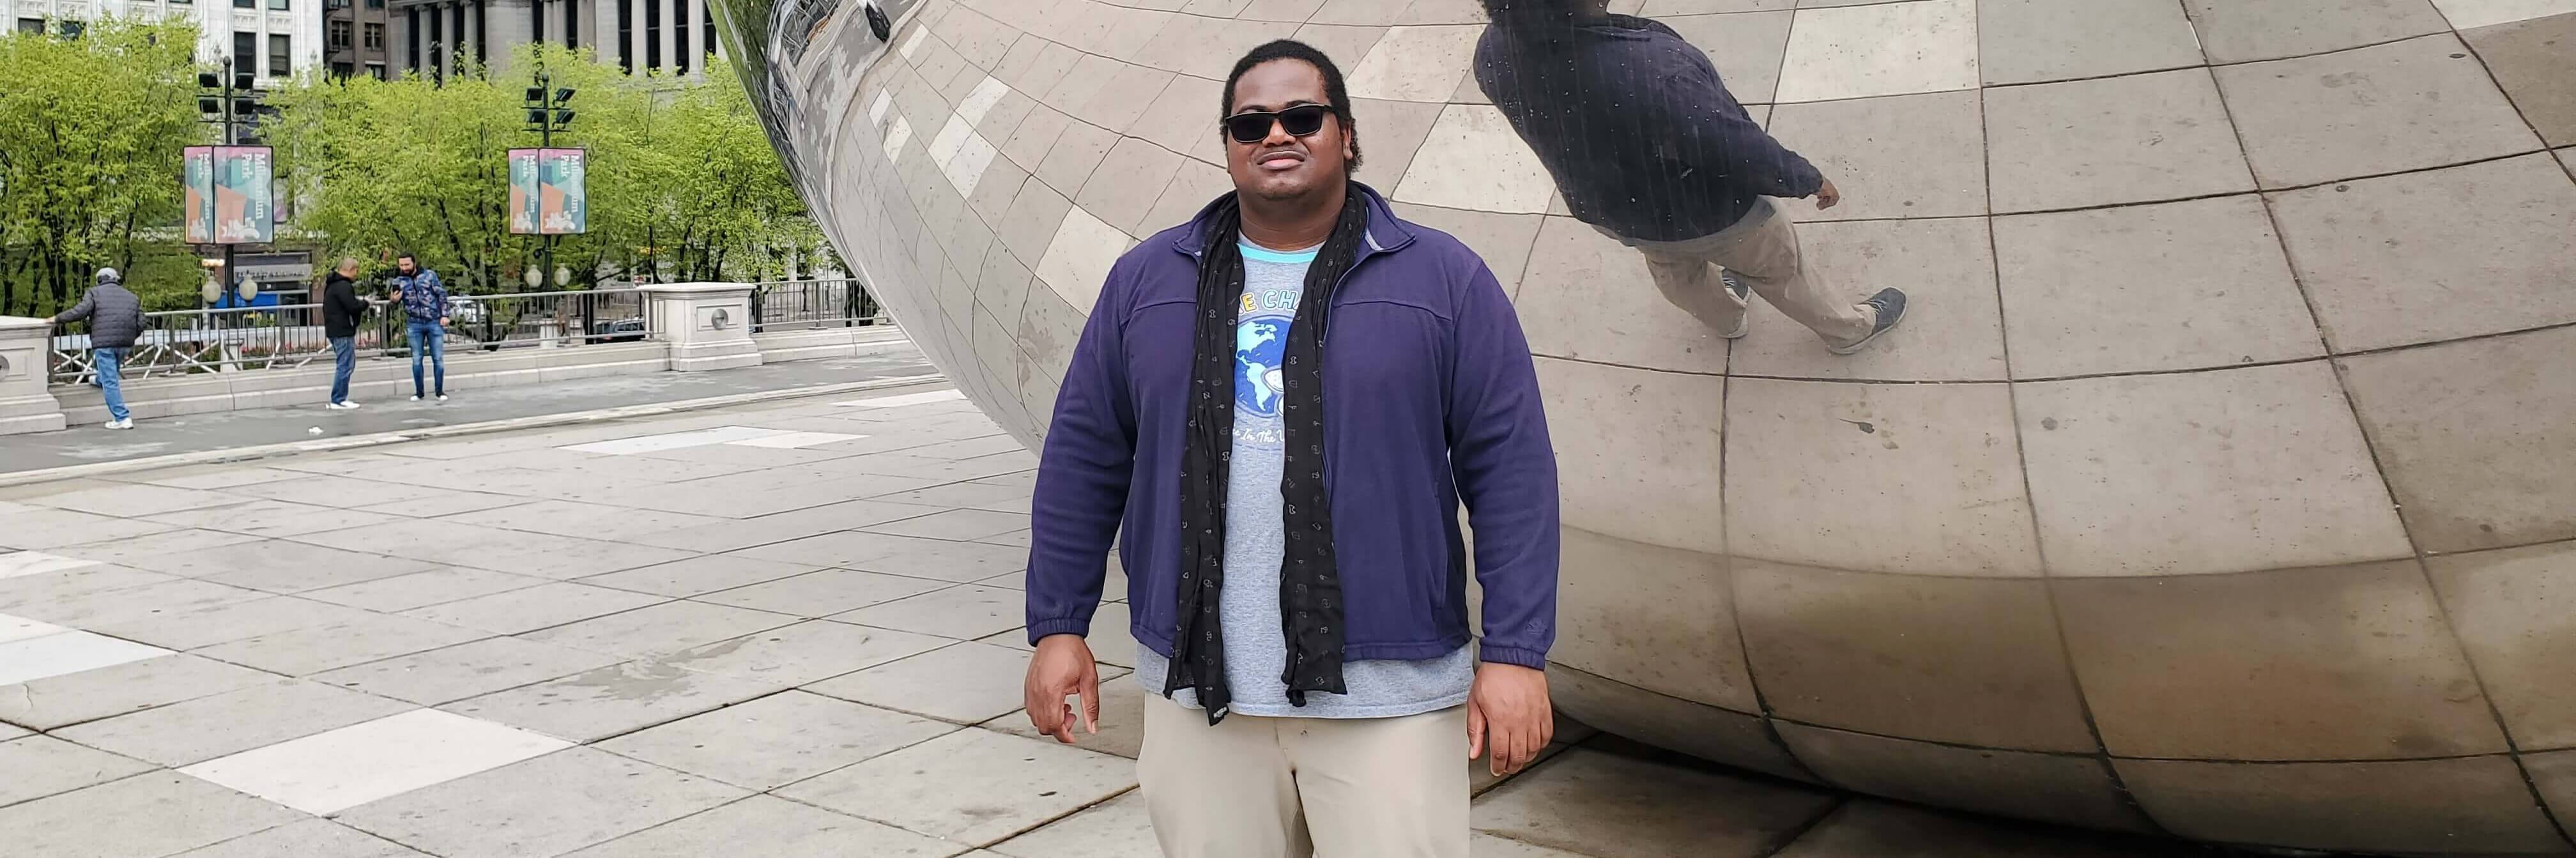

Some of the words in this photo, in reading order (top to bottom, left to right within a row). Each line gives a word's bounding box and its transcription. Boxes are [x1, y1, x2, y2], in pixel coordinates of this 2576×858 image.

[241, 153, 253, 179] Park
[560, 155, 571, 178] Park
[255, 153, 266, 220] Millennium
[571, 155, 580, 213] Millum
[1238, 292, 1259, 316] E
[1241, 427, 1256, 441] In
[1257, 429, 1276, 443] The
